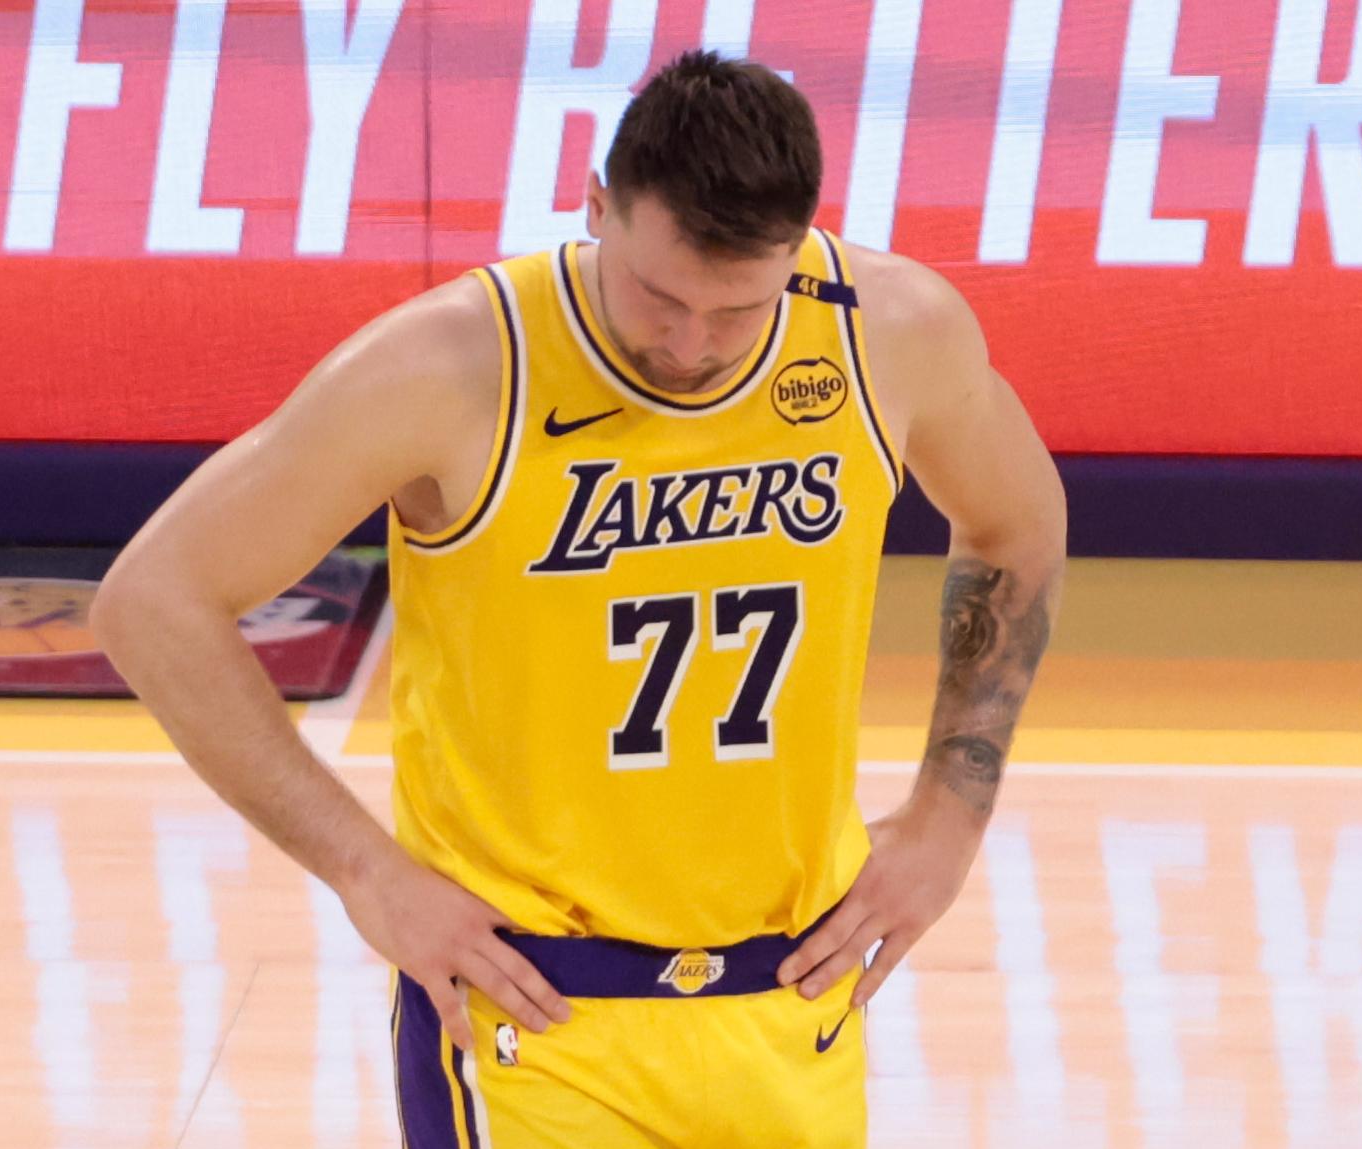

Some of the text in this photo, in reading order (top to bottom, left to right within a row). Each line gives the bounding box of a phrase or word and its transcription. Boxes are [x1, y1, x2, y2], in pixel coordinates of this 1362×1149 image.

[1, 0, 406, 255] FLY
[798, 277, 820, 297] 44
[778, 376, 842, 402] bibigo
[526, 453, 844, 576] LAKERS
[608, 581, 804, 770] 77
